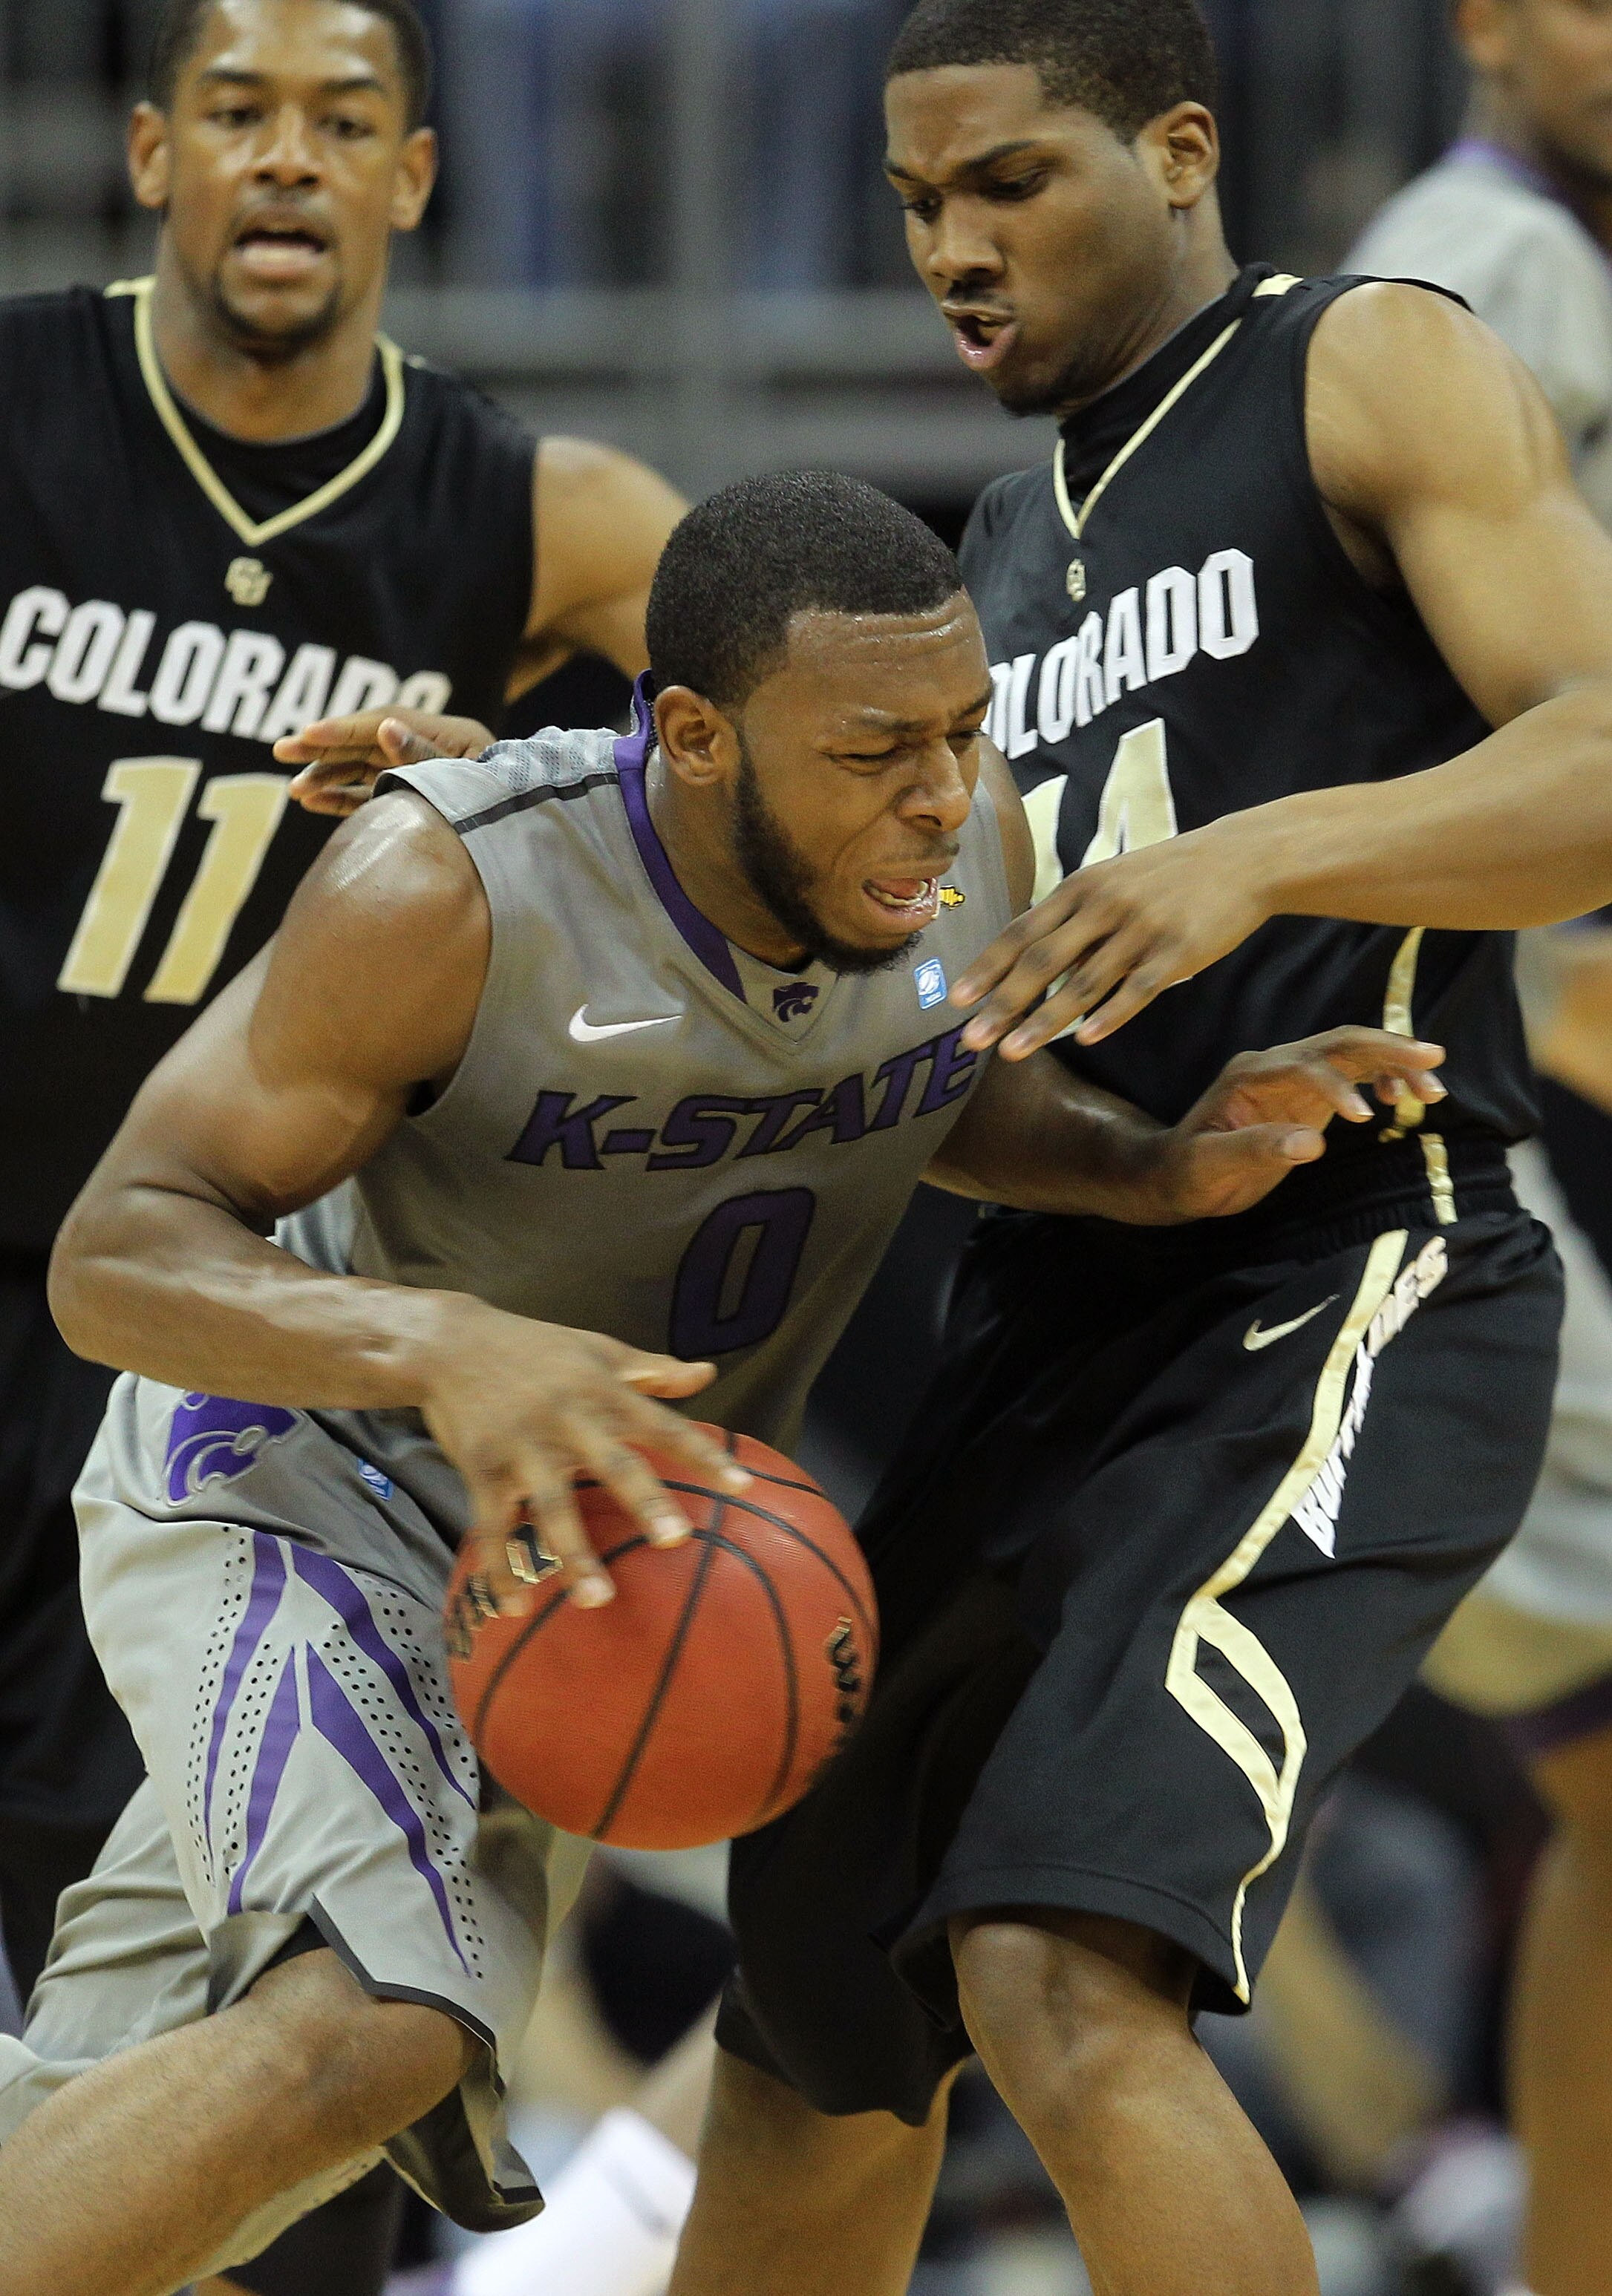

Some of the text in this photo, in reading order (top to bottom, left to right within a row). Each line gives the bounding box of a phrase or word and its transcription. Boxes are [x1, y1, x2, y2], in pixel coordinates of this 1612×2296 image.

[980, 548, 1260, 760] OLORADO
[57, 755, 292, 1005] 11
[503, 1014, 979, 1171] K-STATE
[672, 1186, 815, 1360] 0
